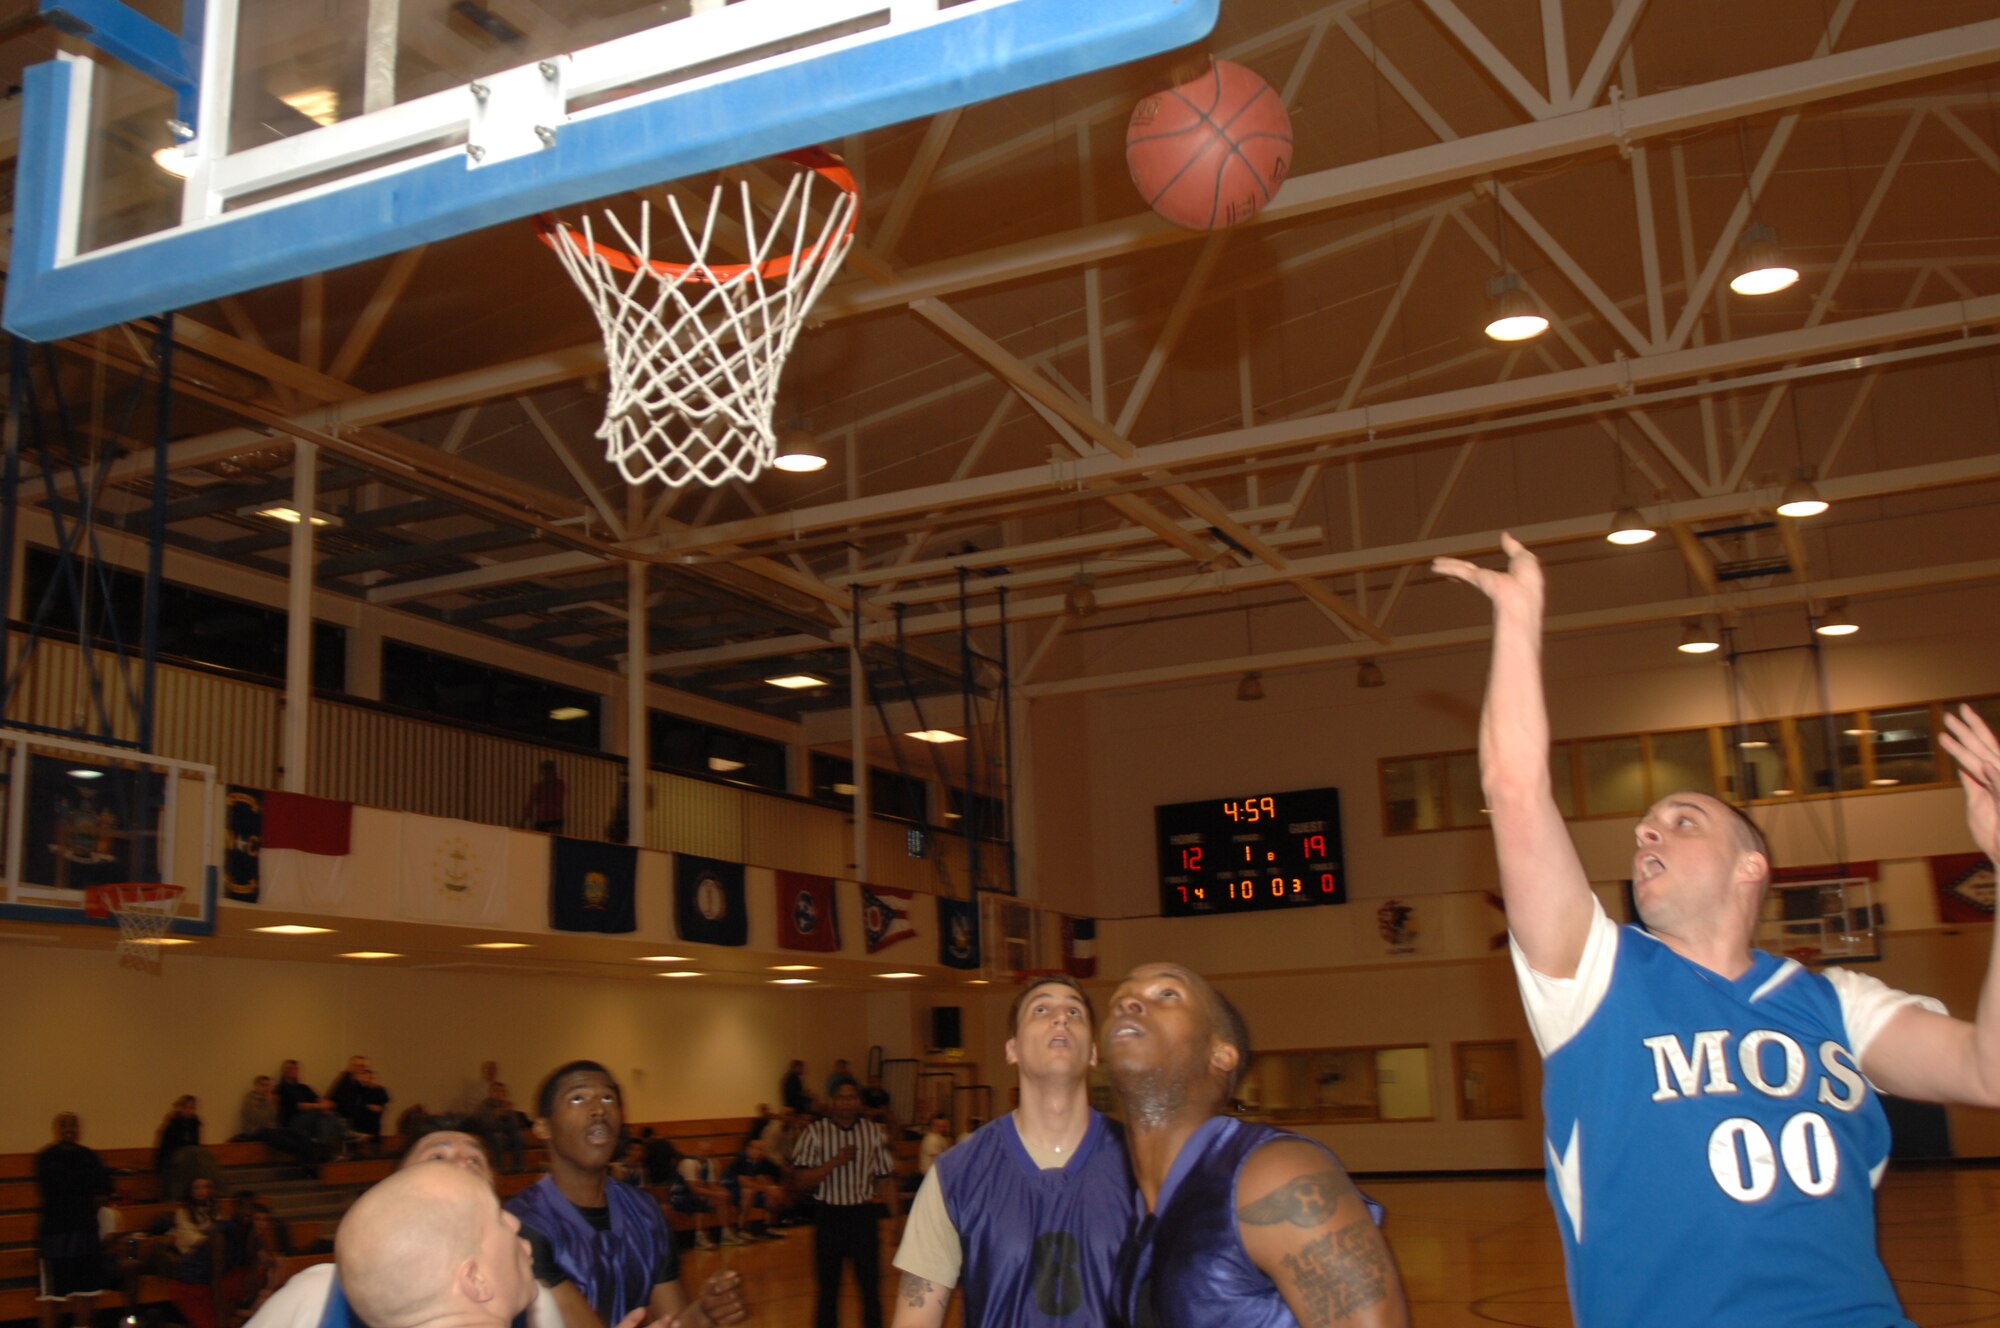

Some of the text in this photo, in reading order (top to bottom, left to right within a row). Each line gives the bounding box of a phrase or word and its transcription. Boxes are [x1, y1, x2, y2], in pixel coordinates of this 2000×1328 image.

[1224, 797, 1275, 822] 4:59
[1289, 821, 1324, 834] GUEST
[1245, 845, 1251, 861] 1
[1304, 836, 1325, 858] 19
[1182, 847, 1202, 870] 12
[1229, 880, 1253, 899] 10
[1271, 877, 1284, 896] 0
[1292, 879, 1301, 892] 3
[1321, 873, 1334, 893] 0
[1177, 886, 1188, 902] 7
[1194, 888, 1205, 899] 4
[1643, 1029, 1867, 1112] MOS
[1707, 1111, 1839, 1203] 00
[1034, 1231, 1081, 1316] 8
